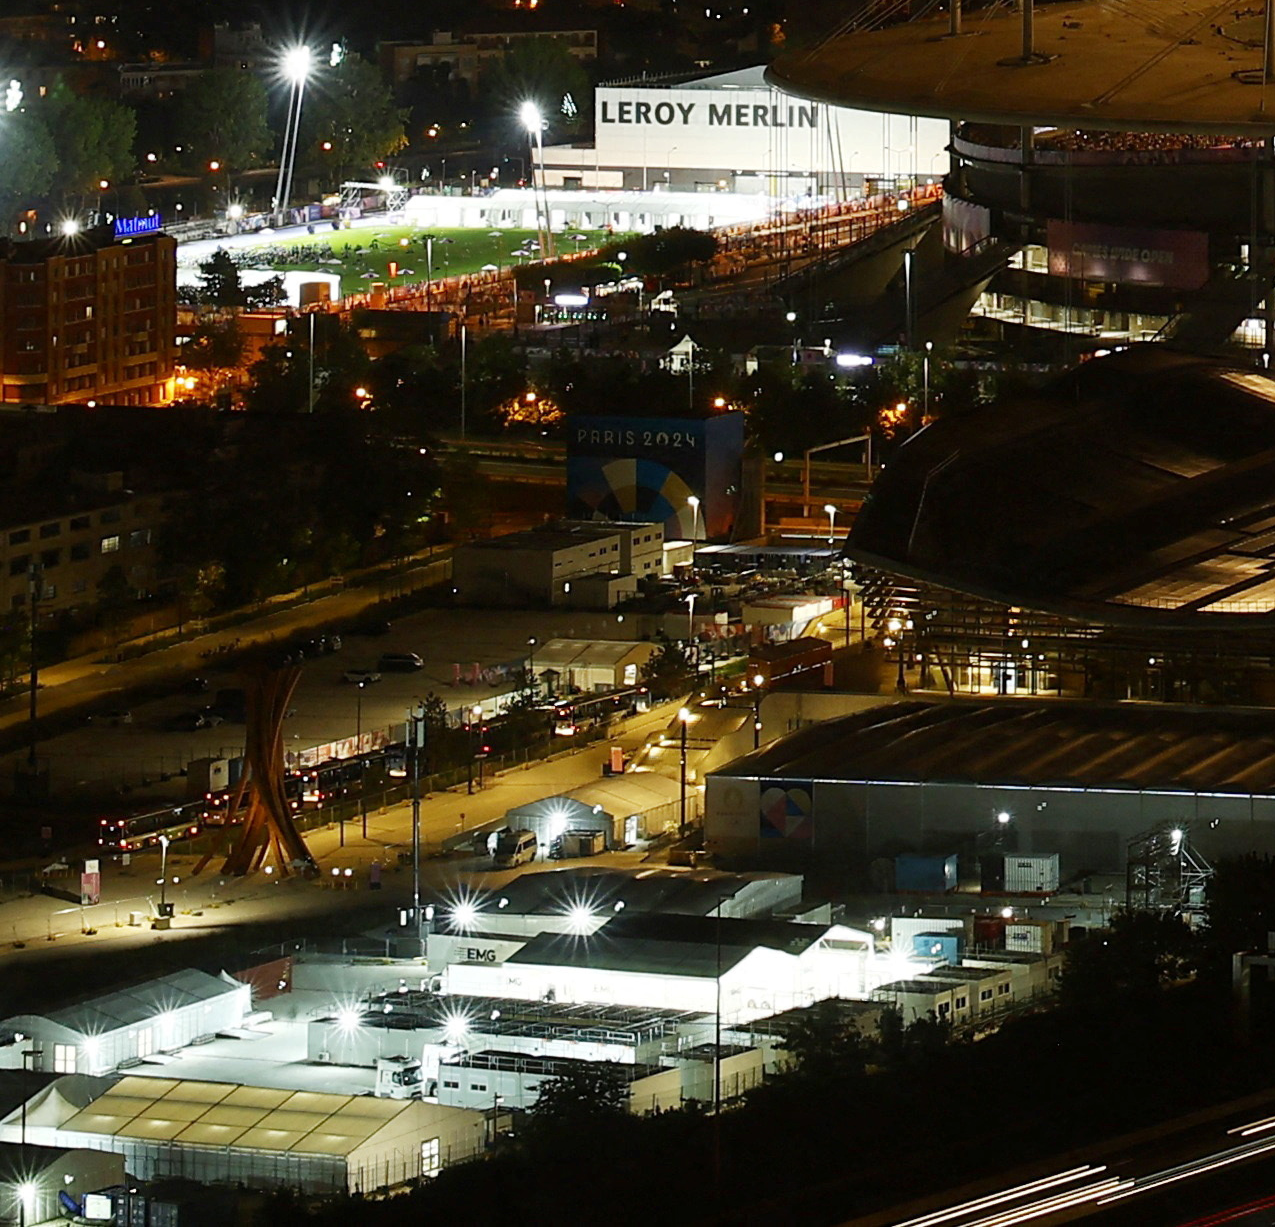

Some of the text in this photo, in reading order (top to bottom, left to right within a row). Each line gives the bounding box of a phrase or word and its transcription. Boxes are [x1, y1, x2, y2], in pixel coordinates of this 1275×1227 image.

[602, 101, 818, 128] LEROY MERLIN
[1141, 249, 1174, 263] OPEN
[577, 429, 696, 448] PARIS 2024
[467, 948, 496, 962] EMG
